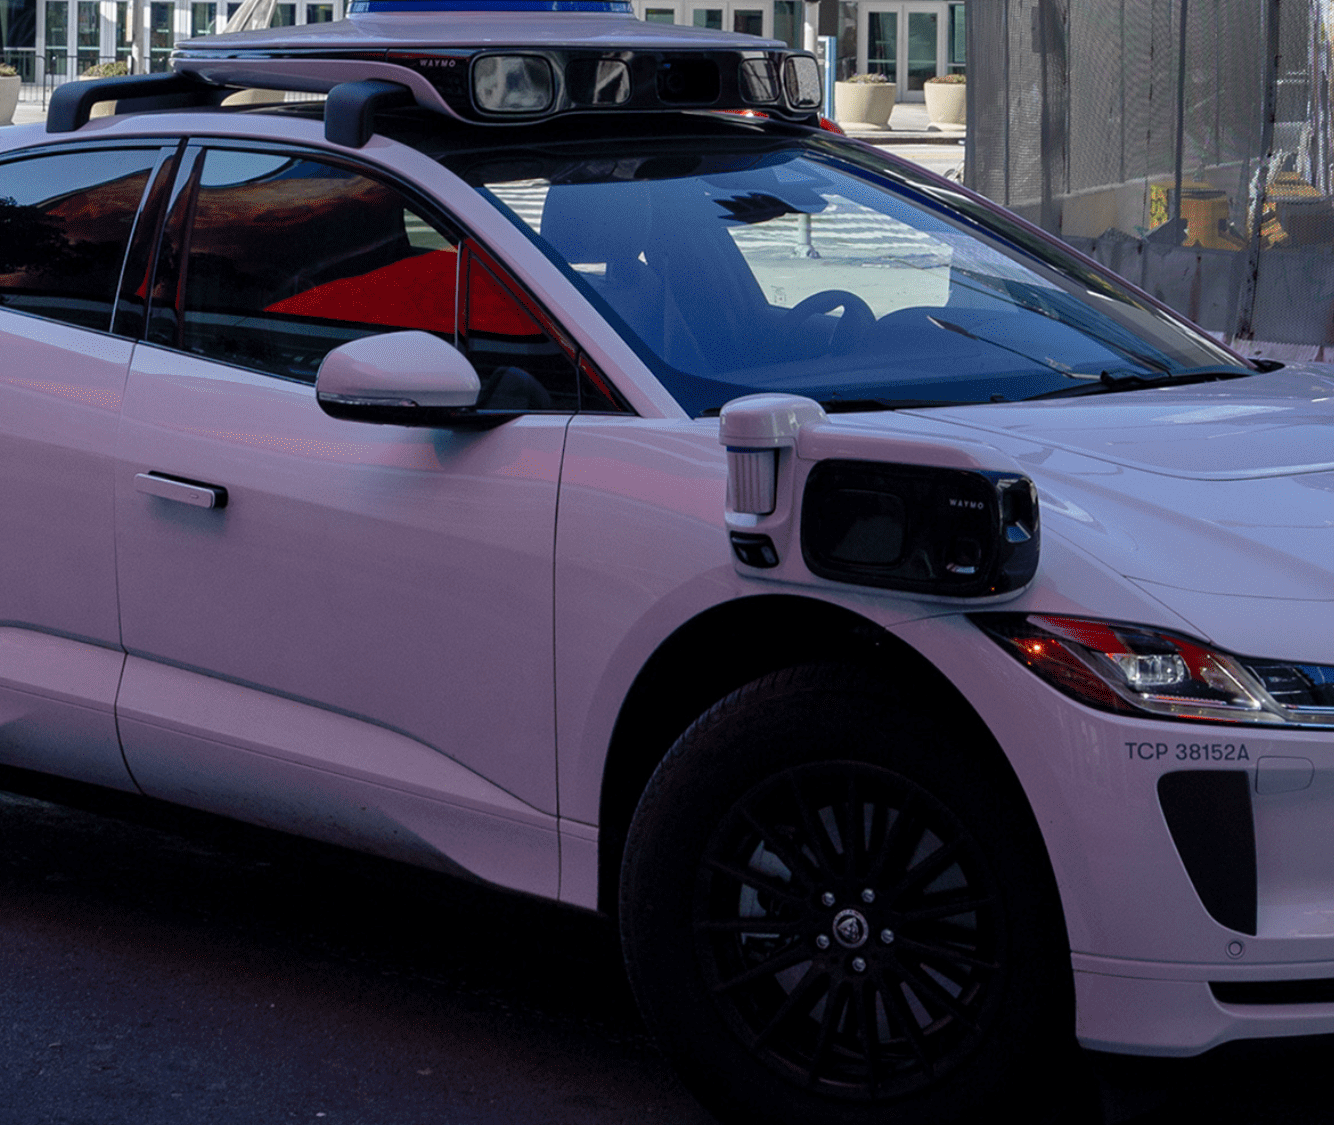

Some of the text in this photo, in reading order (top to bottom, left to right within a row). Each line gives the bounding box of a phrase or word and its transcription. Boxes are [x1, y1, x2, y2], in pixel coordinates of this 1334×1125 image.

[419, 59, 456, 67] WAYMO
[949, 498, 985, 510] WAYMO
[1124, 742, 1250, 761] TCP 38152A
